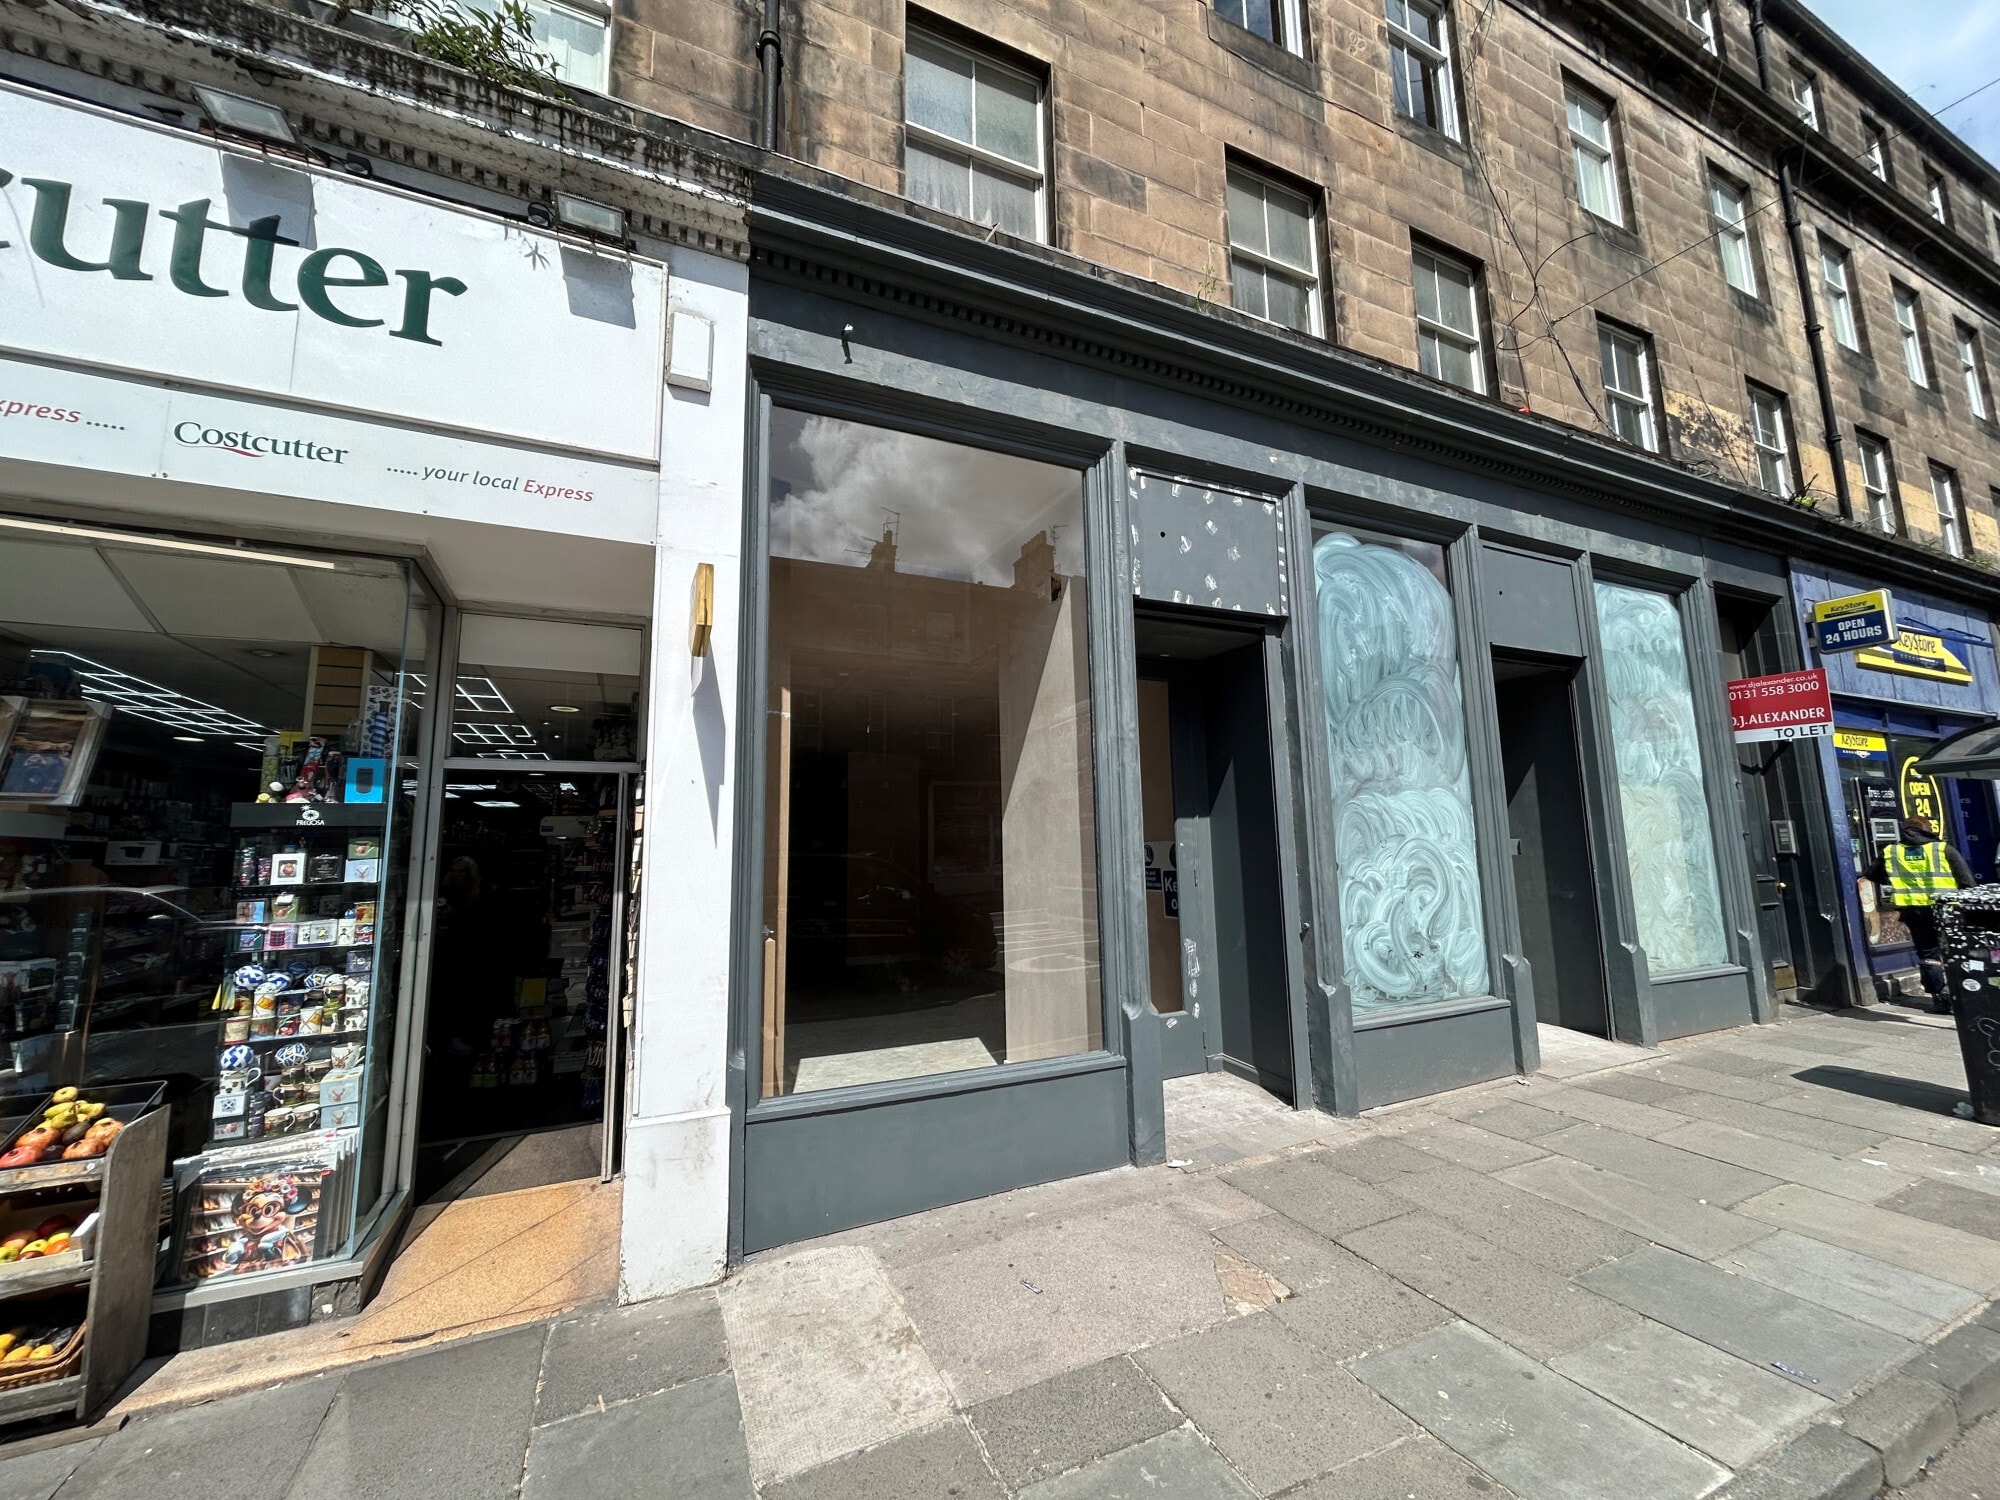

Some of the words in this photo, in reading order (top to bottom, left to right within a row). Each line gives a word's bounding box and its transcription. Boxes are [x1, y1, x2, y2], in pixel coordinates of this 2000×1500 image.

[0, 168, 468, 347] utter
[174, 421, 349, 464] Costcutter
[422, 466, 469, 482] your
[472, 470, 519, 491] local
[523, 479, 594, 502] Express
[1837, 617, 1866, 631] OPEN
[1825, 633, 1841, 645] 24
[1843, 625, 1882, 641] HOURS
[1728, 672, 1818, 690] www.djalexander.co.uk
[1728, 689, 1757, 701] 0131
[1761, 685, 1785, 697] 558
[1787, 681, 1819, 694] 3000
[1774, 727, 1795, 739] TO
[1800, 724, 1829, 737] LET
[1909, 781, 1931, 796] OPEN
[1915, 798, 1932, 817] 24
